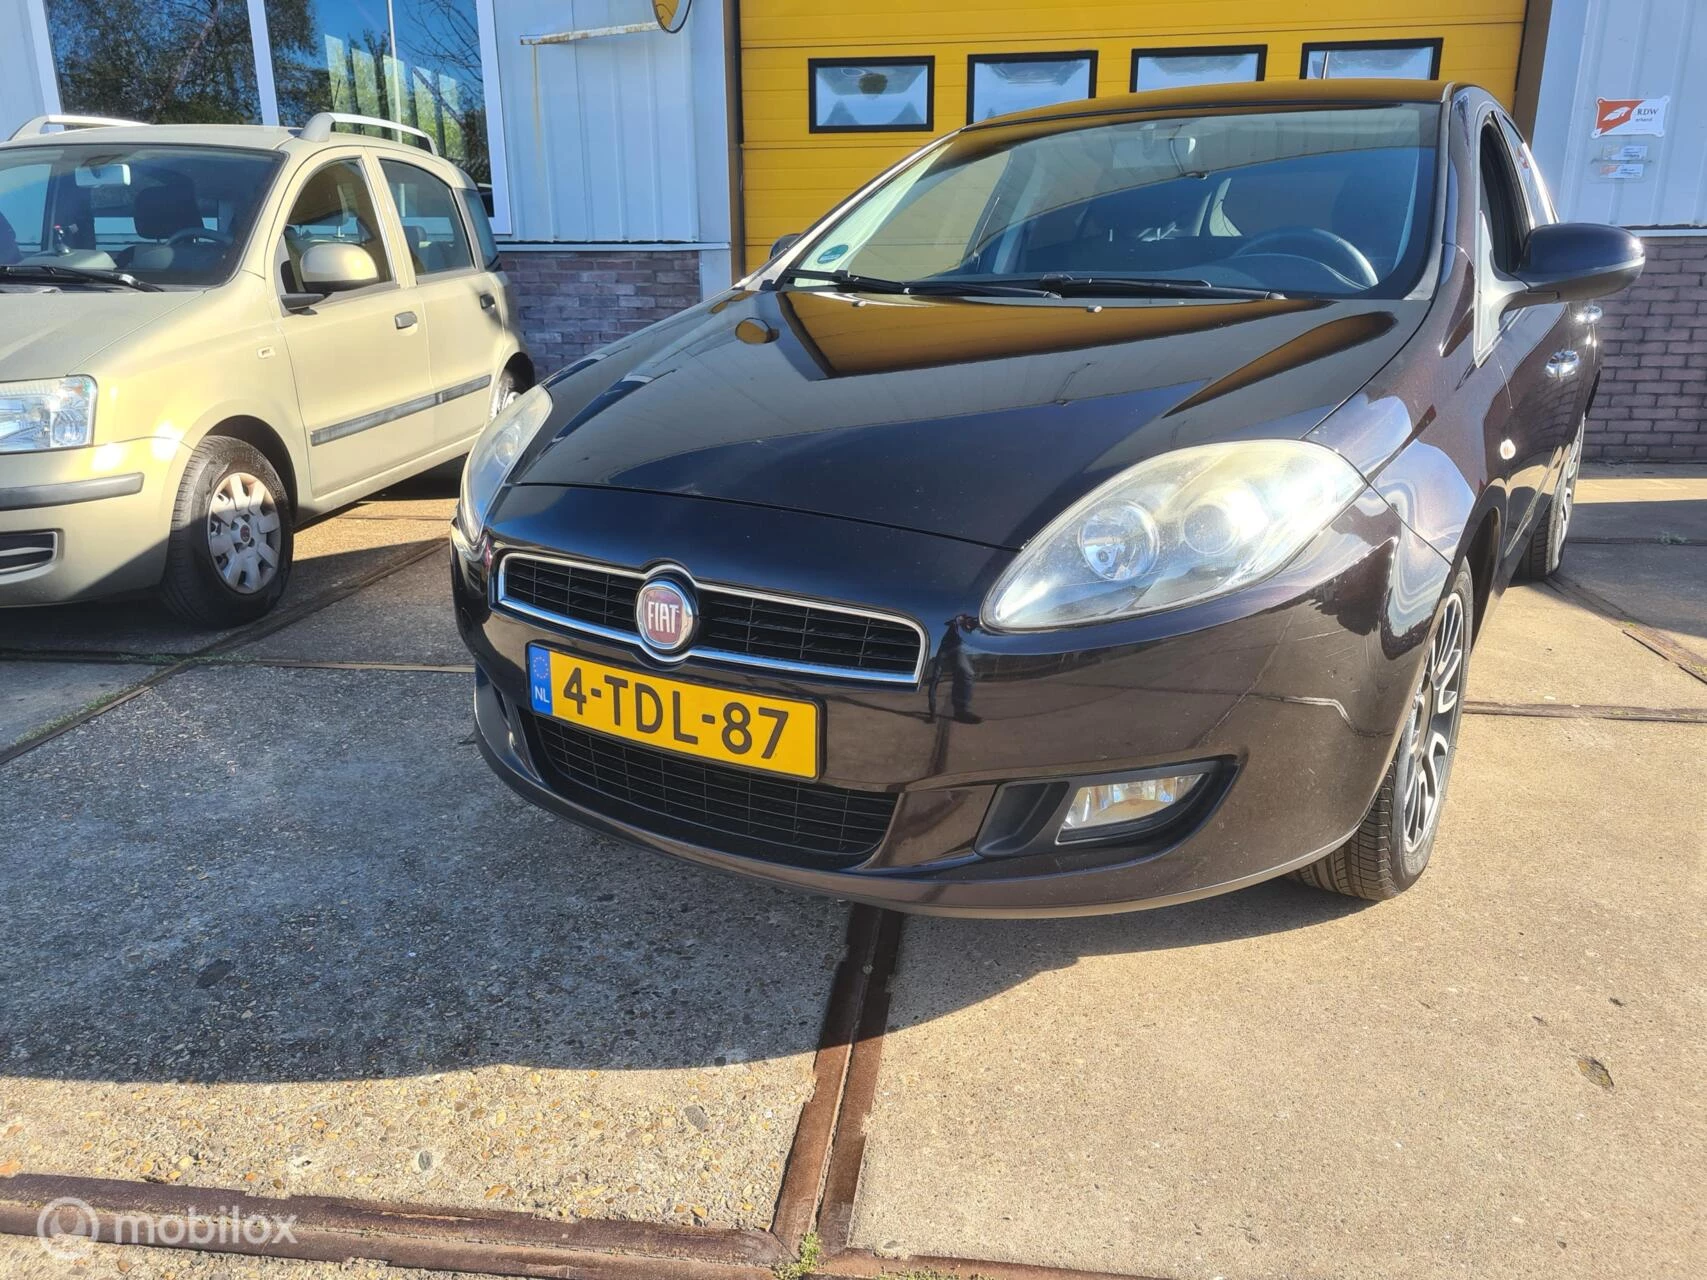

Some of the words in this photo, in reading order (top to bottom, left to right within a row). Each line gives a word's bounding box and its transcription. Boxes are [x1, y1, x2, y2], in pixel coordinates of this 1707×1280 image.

[1636, 108, 1659, 116] RDW
[647, 601, 680, 634] FIAT
[534, 685, 550, 704] NL
[563, 667, 789, 759] 4-TDL-87
